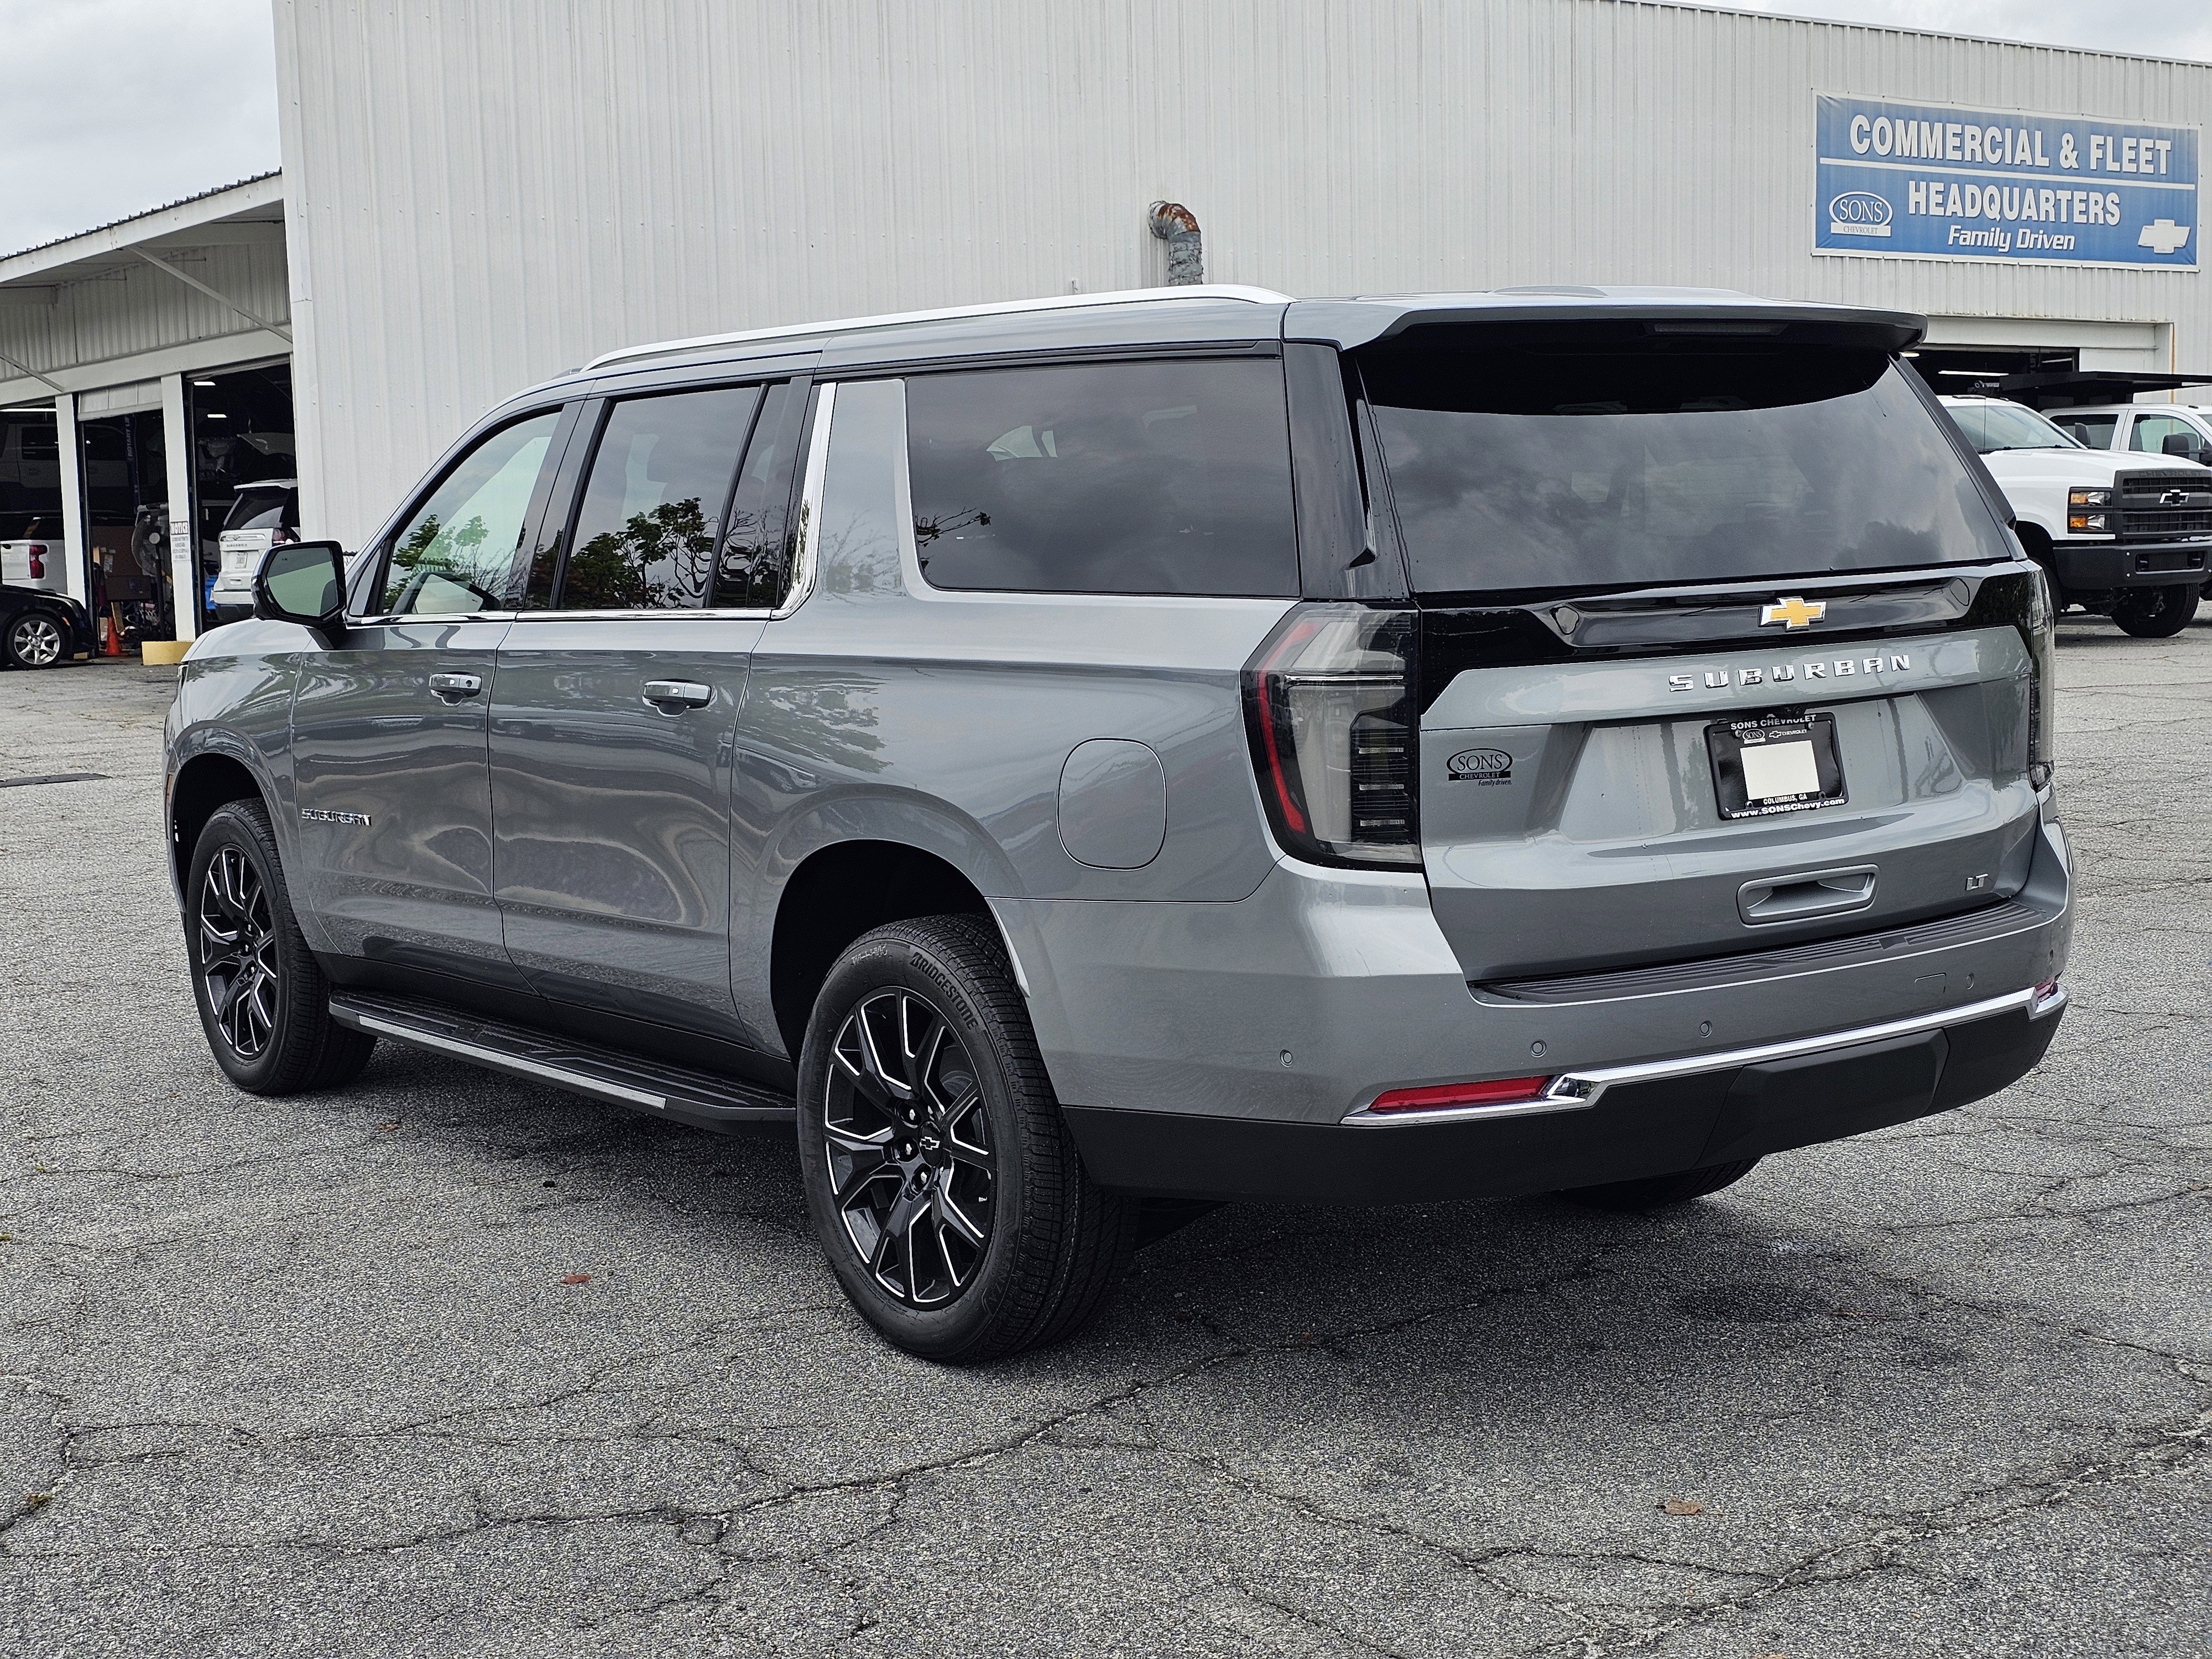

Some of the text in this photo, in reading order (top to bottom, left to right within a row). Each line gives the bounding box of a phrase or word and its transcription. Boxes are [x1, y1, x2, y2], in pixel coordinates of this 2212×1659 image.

[1850, 114, 2171, 175] COMMERCIAL & FLEET
[1839, 199, 1883, 222] SONS
[1908, 180, 2120, 226] HEADQUARTERS
[1843, 226, 1878, 234] CHEVROLET
[1948, 225, 2075, 252] Family Driven
[170, 522, 189, 535] NOTICE
[1668, 654, 1911, 692] SUBURBAN
[1730, 721, 1758, 730] SONS
[1745, 731, 1762, 739] SONS
[1457, 754, 1503, 771] SONS
[301, 808, 372, 826] SUBURBAN
[1730, 798, 1845, 819] www.SONSChevy.com
[1965, 873, 1989, 891] LT
[909, 952, 979, 1030] BRIDGESTONE
